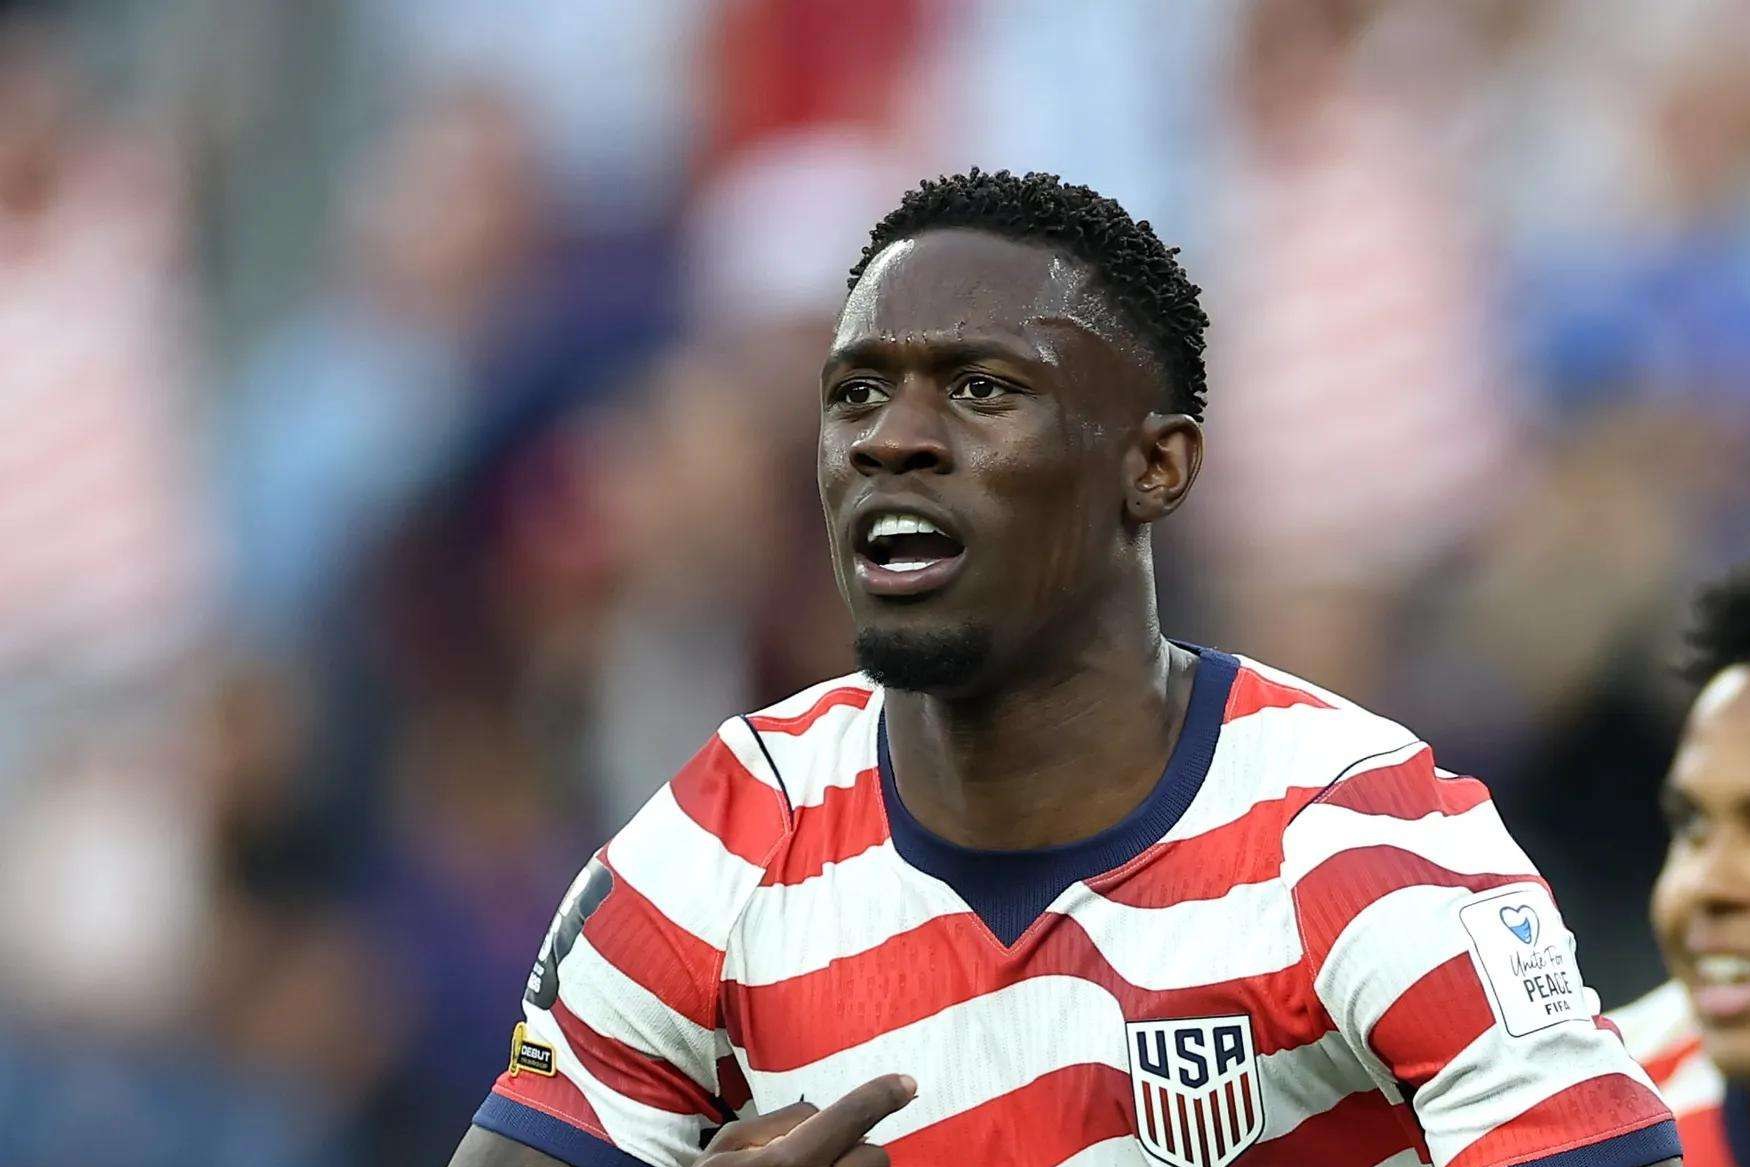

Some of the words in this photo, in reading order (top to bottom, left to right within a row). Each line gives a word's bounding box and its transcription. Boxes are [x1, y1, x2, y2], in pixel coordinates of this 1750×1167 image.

[1523, 971, 1572, 1002] PEACE
[1545, 1000, 1571, 1015] FIFA
[521, 1045, 551, 1062] DEBUT
[1136, 1025, 1246, 1089] USA
